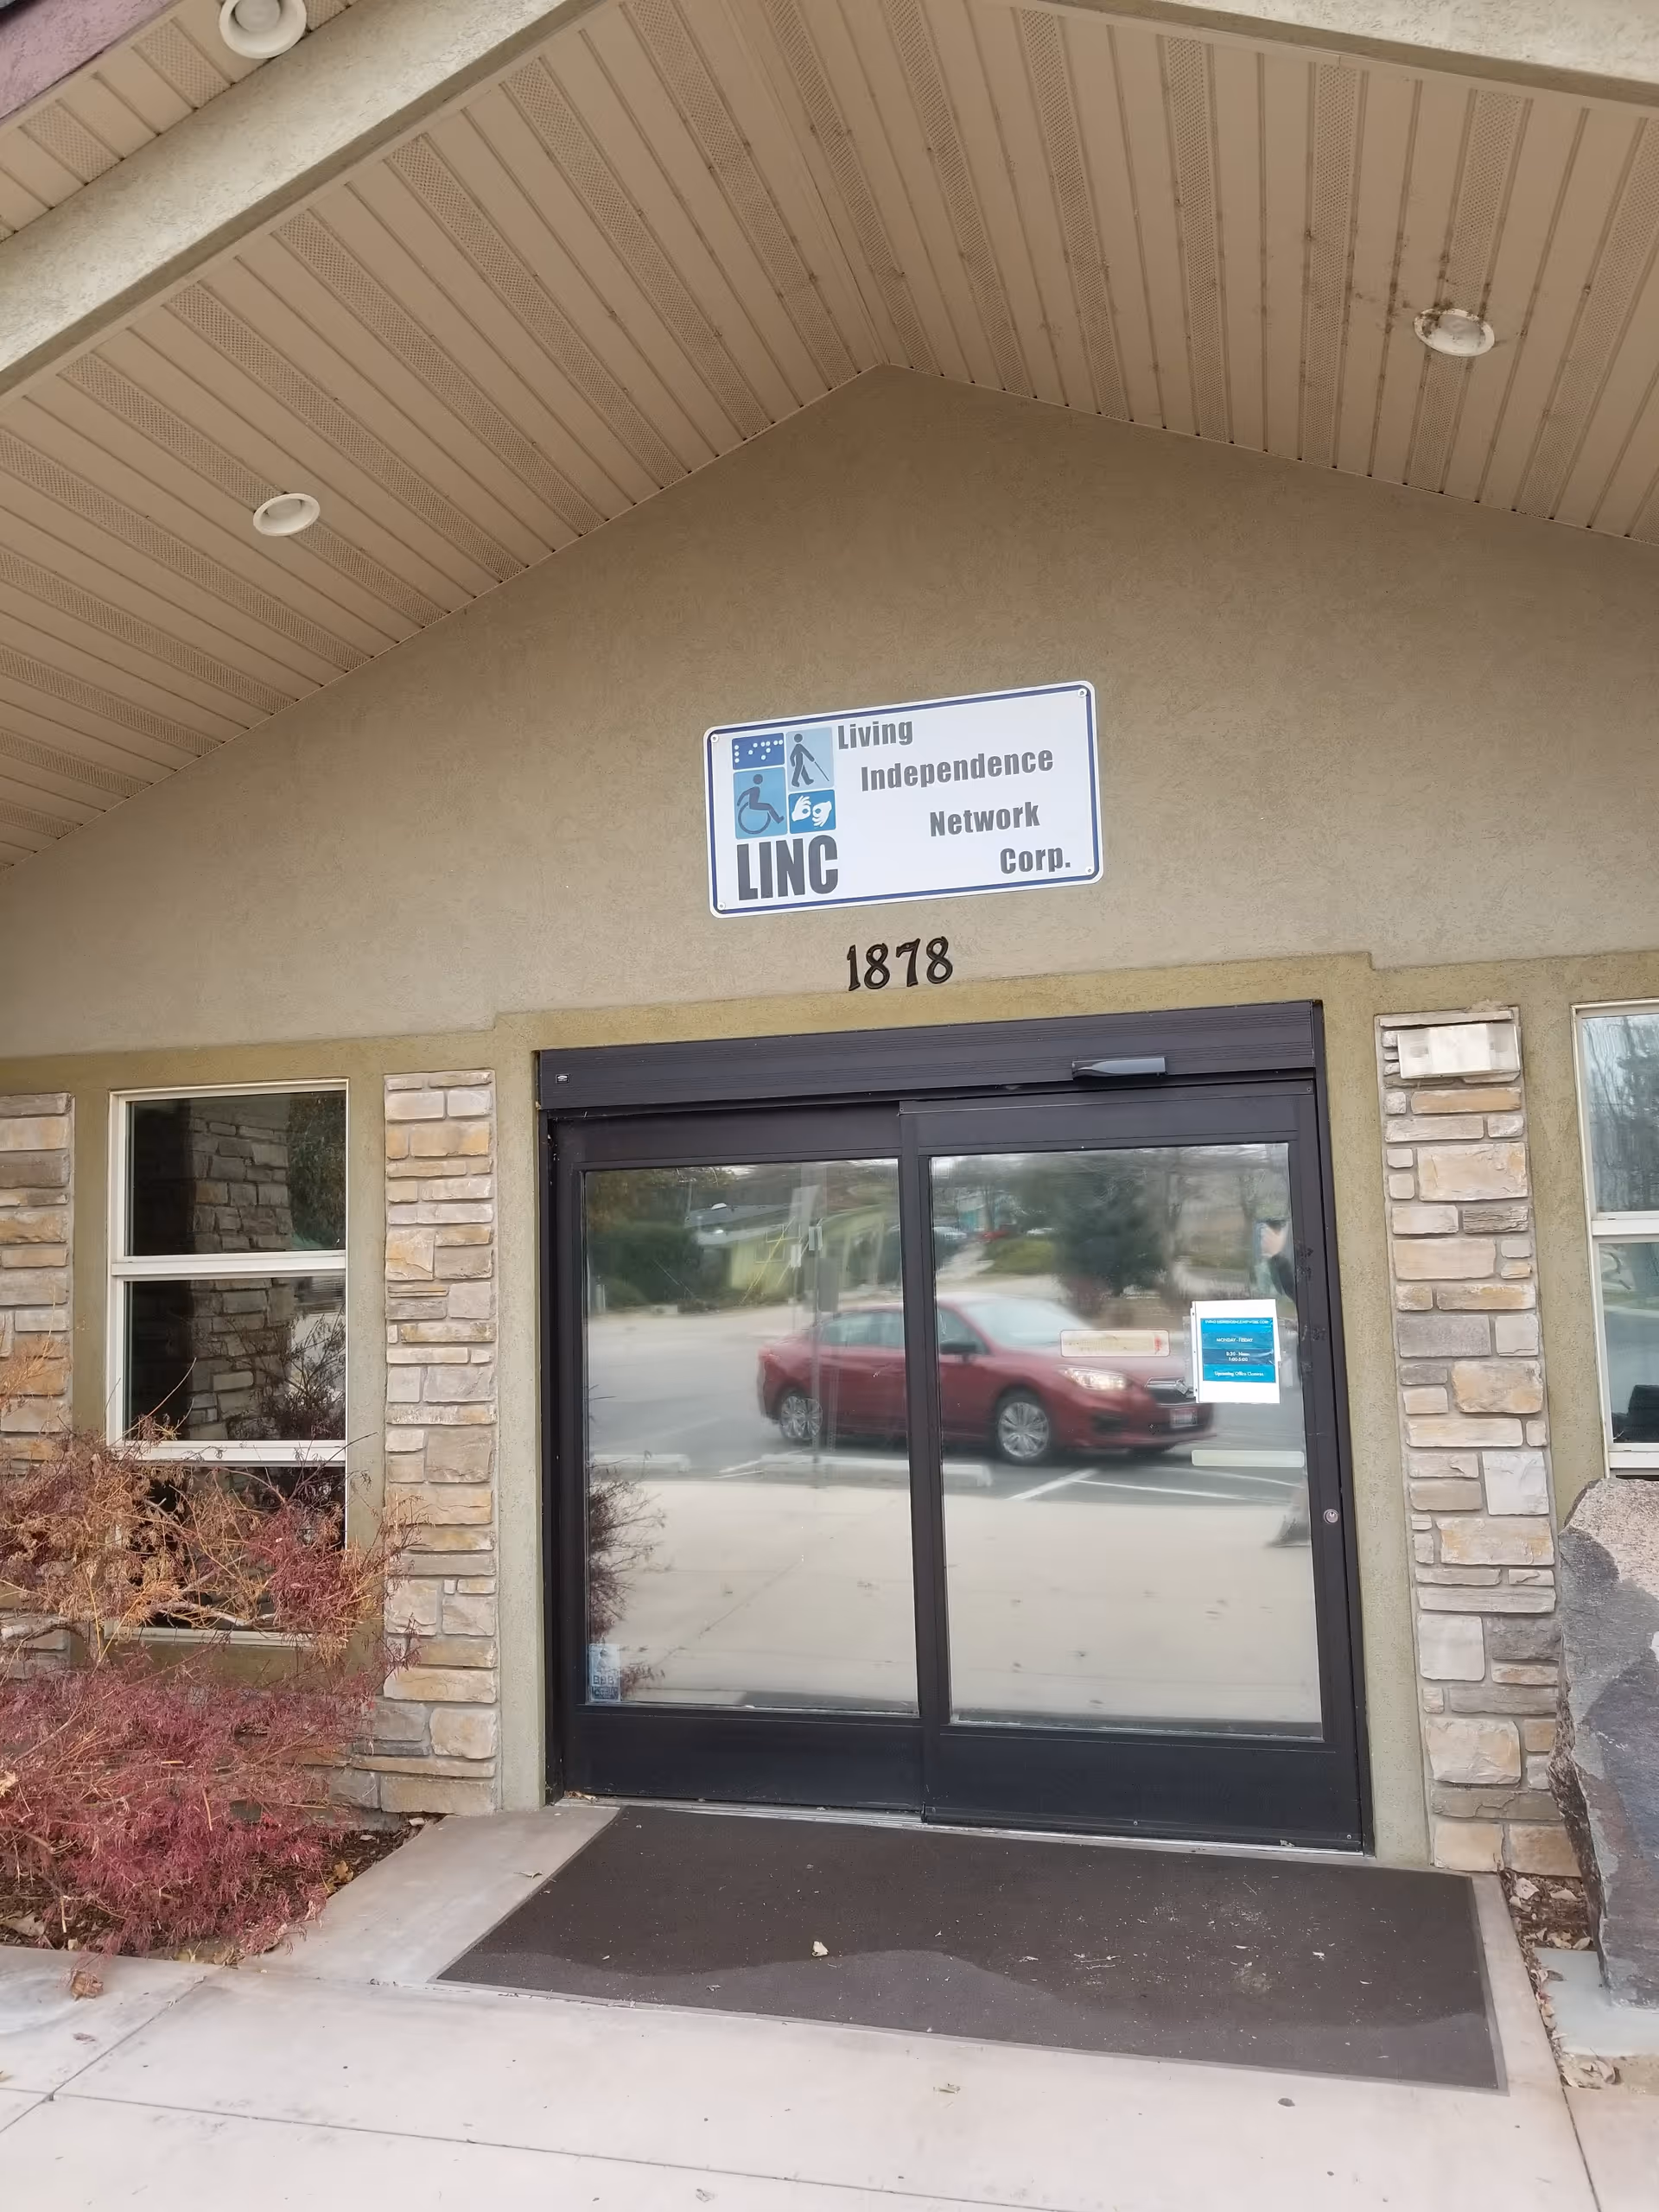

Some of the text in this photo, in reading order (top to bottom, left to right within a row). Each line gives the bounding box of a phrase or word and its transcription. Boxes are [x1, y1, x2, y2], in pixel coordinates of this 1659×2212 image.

[837, 720, 913, 750] Living
[861, 748, 1053, 792] Independence
[930, 801, 1040, 837] Network
[736, 834, 839, 901] LINC
[999, 846, 1071, 875] Corp.
[846, 936, 954, 992] 1878
